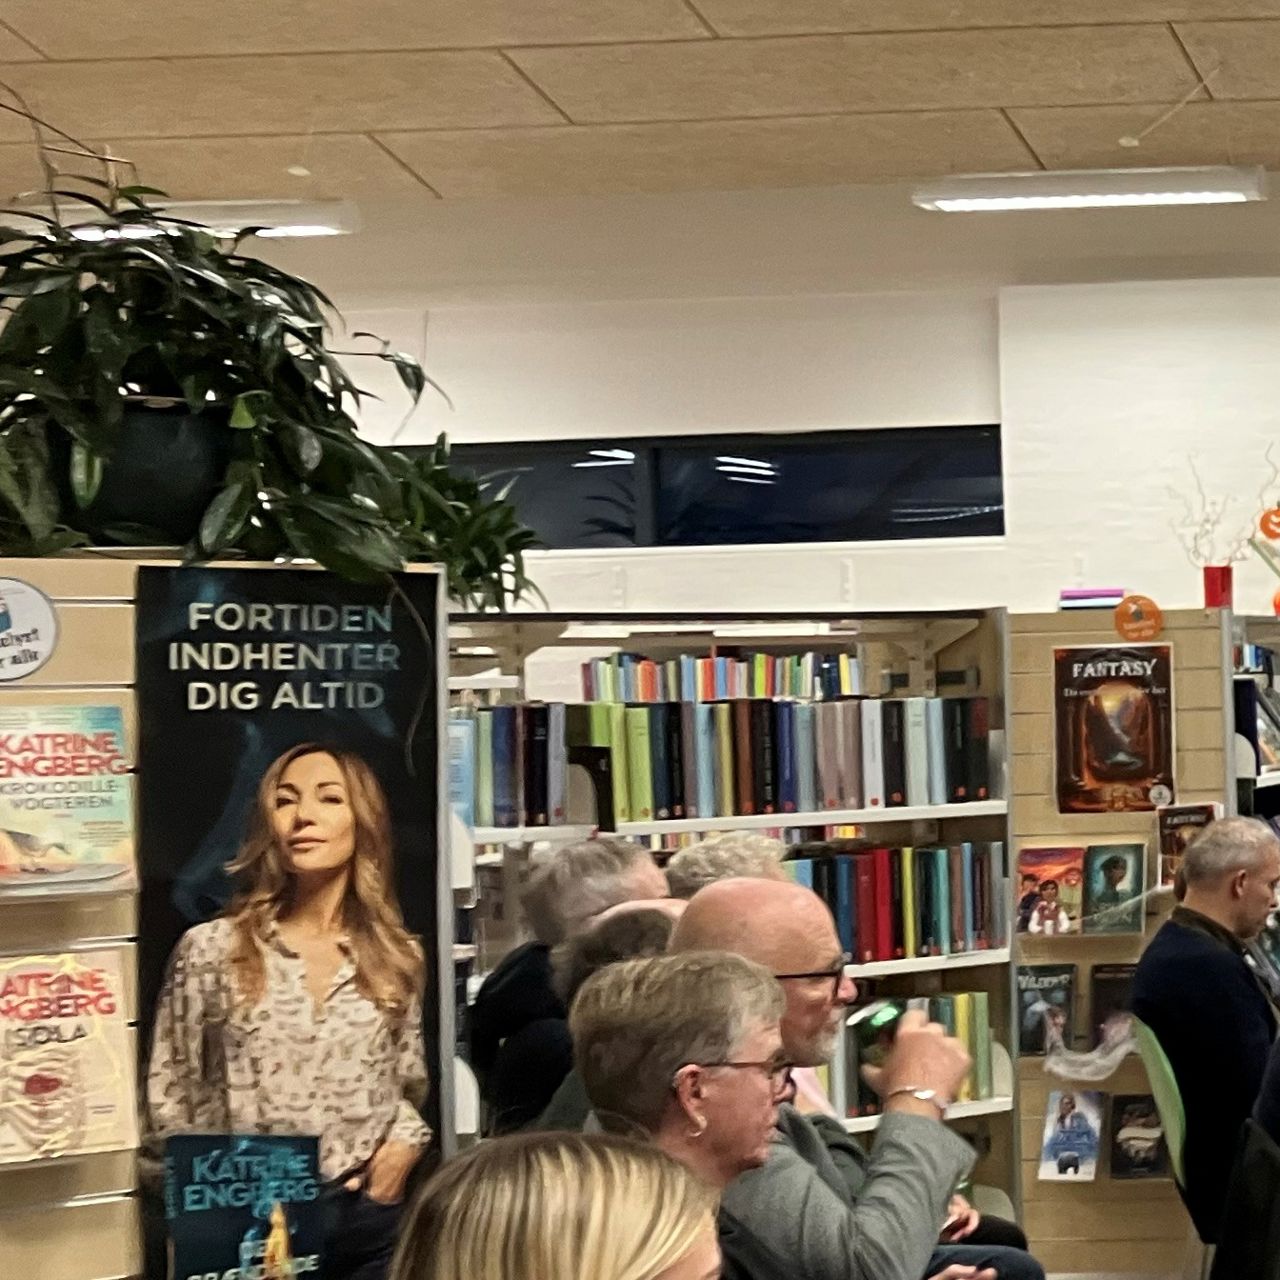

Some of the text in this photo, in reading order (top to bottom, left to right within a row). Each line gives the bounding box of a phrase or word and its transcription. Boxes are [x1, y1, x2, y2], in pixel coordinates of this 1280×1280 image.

[188, 602, 392, 632] FORTIDEN
[168, 641, 401, 671] INDHENTER
[1072, 658, 1158, 678] FANTASY
[187, 681, 385, 711] DIG ALTID
[0, 732, 118, 755] KATRINE
[0, 755, 127, 778] ENGBERG
[0, 969, 106, 998] ATRINE
[0, 992, 116, 1020] NGBERG
